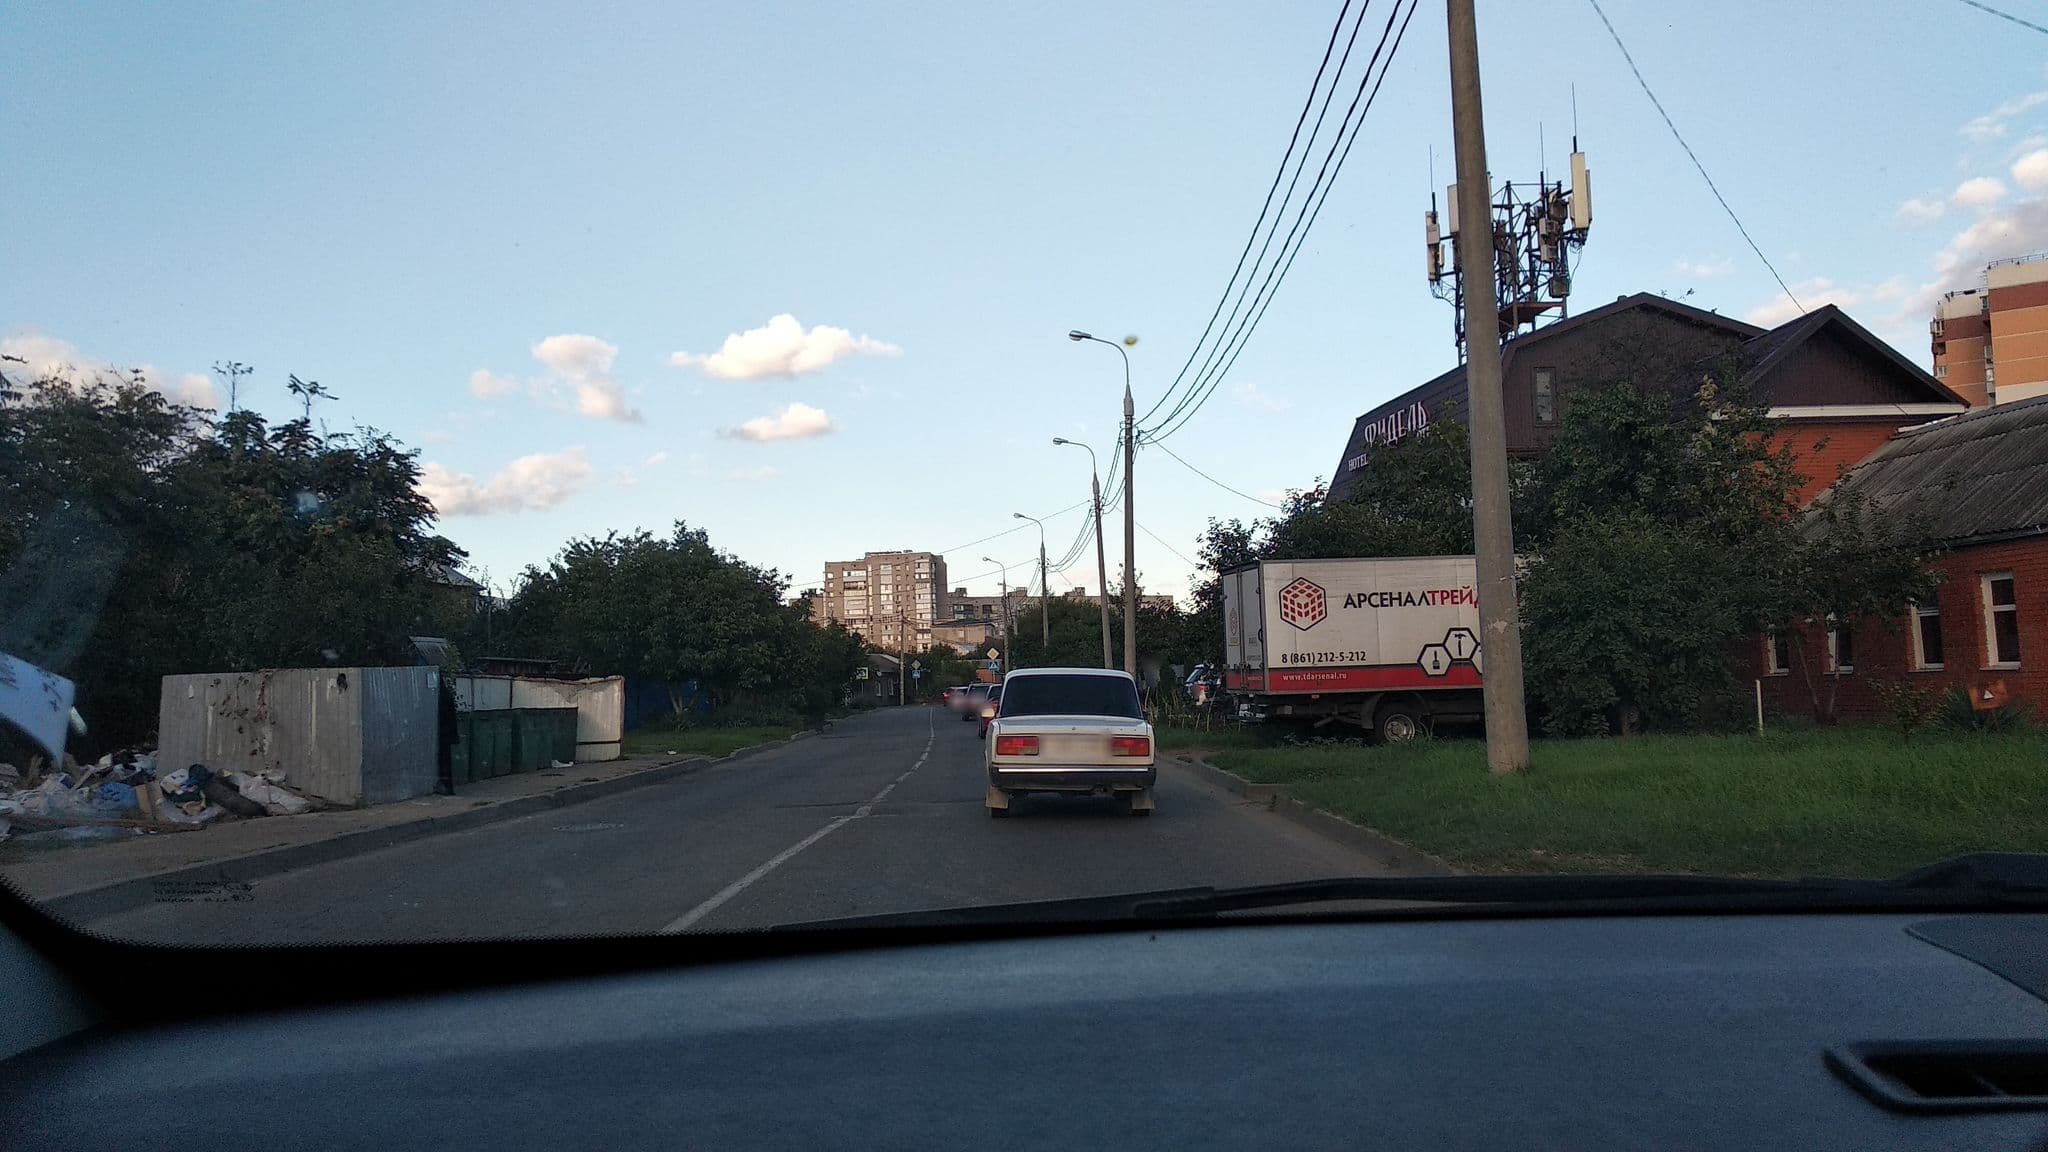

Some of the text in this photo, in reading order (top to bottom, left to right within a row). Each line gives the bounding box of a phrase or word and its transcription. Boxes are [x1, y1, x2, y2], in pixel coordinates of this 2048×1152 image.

[1364, 401, 1428, 448] ФИДЕЛЬ
[1348, 453, 1369, 472] HOTEL
[1281, 651, 1367, 665] 8 (861) 212-5-212
[1282, 671, 1347, 682] www.tdarsenal.ru
